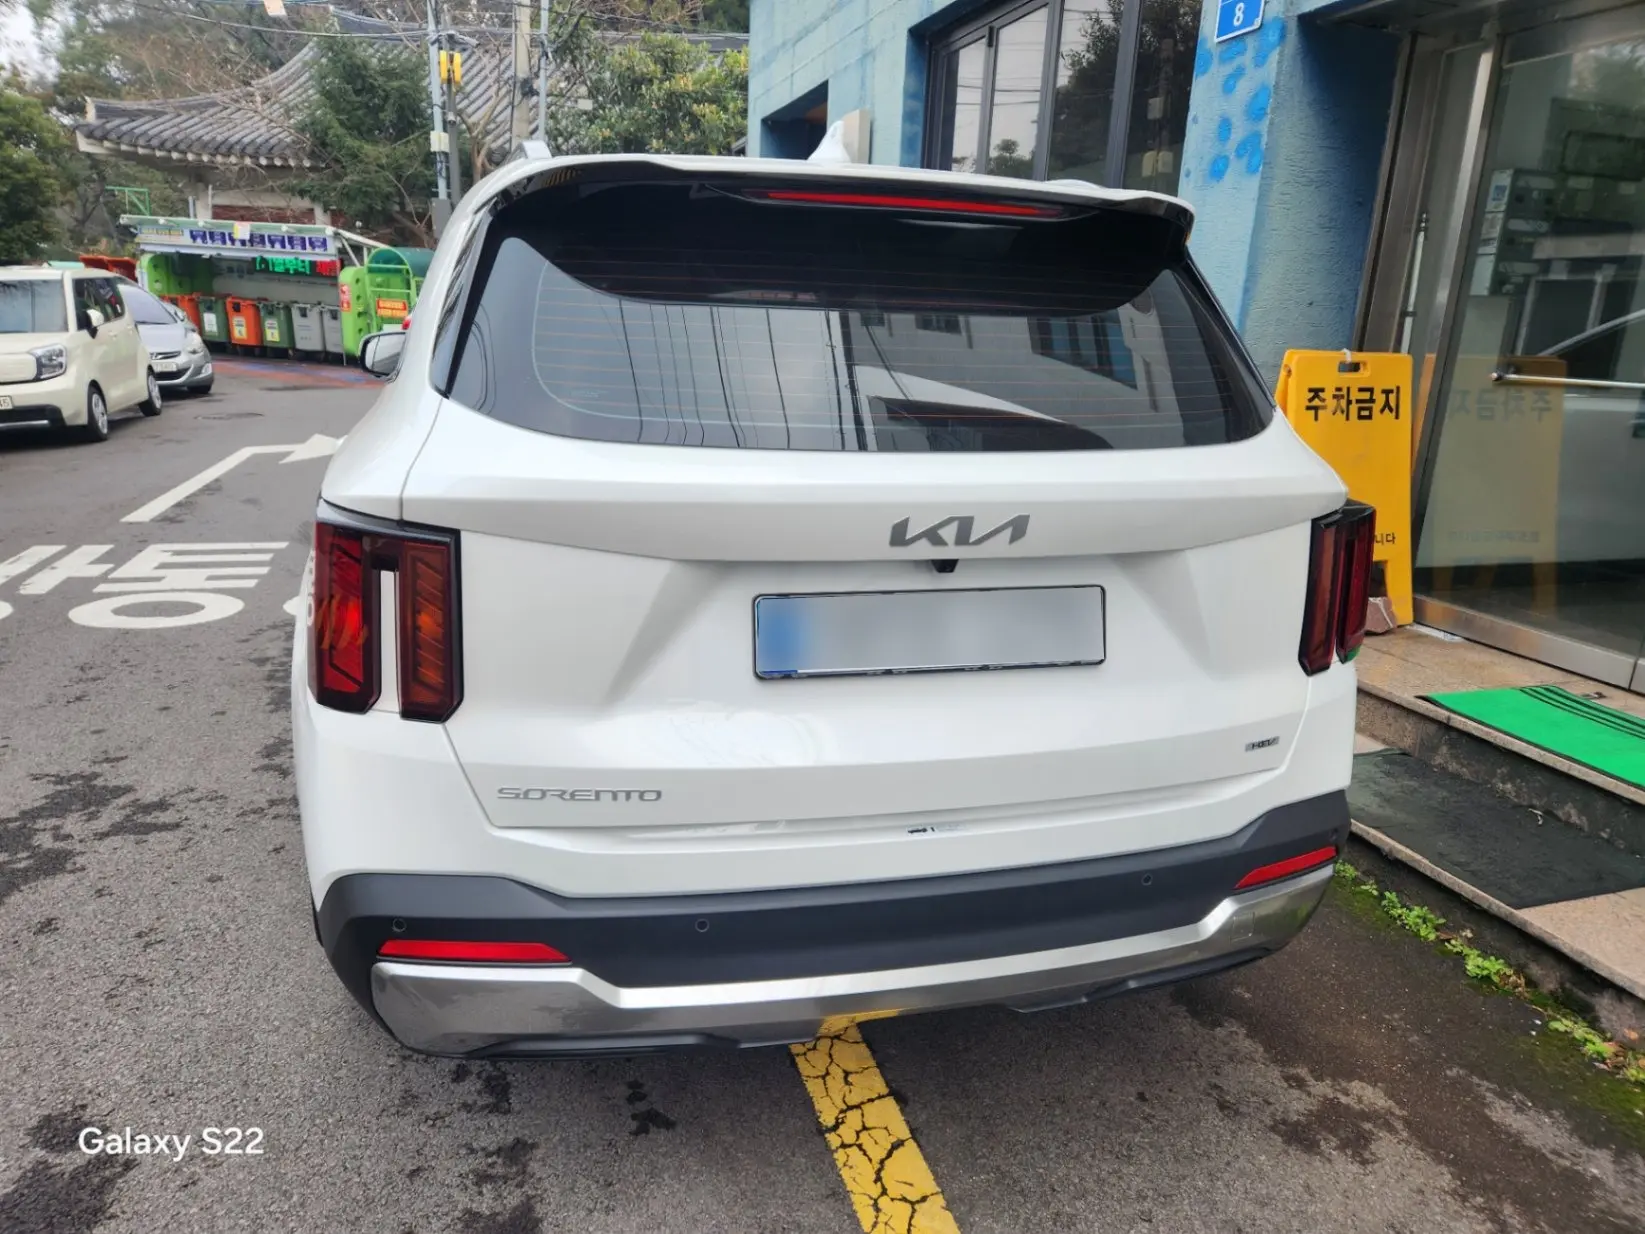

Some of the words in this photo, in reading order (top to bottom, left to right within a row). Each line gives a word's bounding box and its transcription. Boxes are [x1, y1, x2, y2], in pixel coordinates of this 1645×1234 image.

[1233, 2, 1245, 27] 8
[1305, 385, 1401, 420] 주차금지
[889, 514, 1031, 547] KIA
[497, 787, 662, 802] SORENTO
